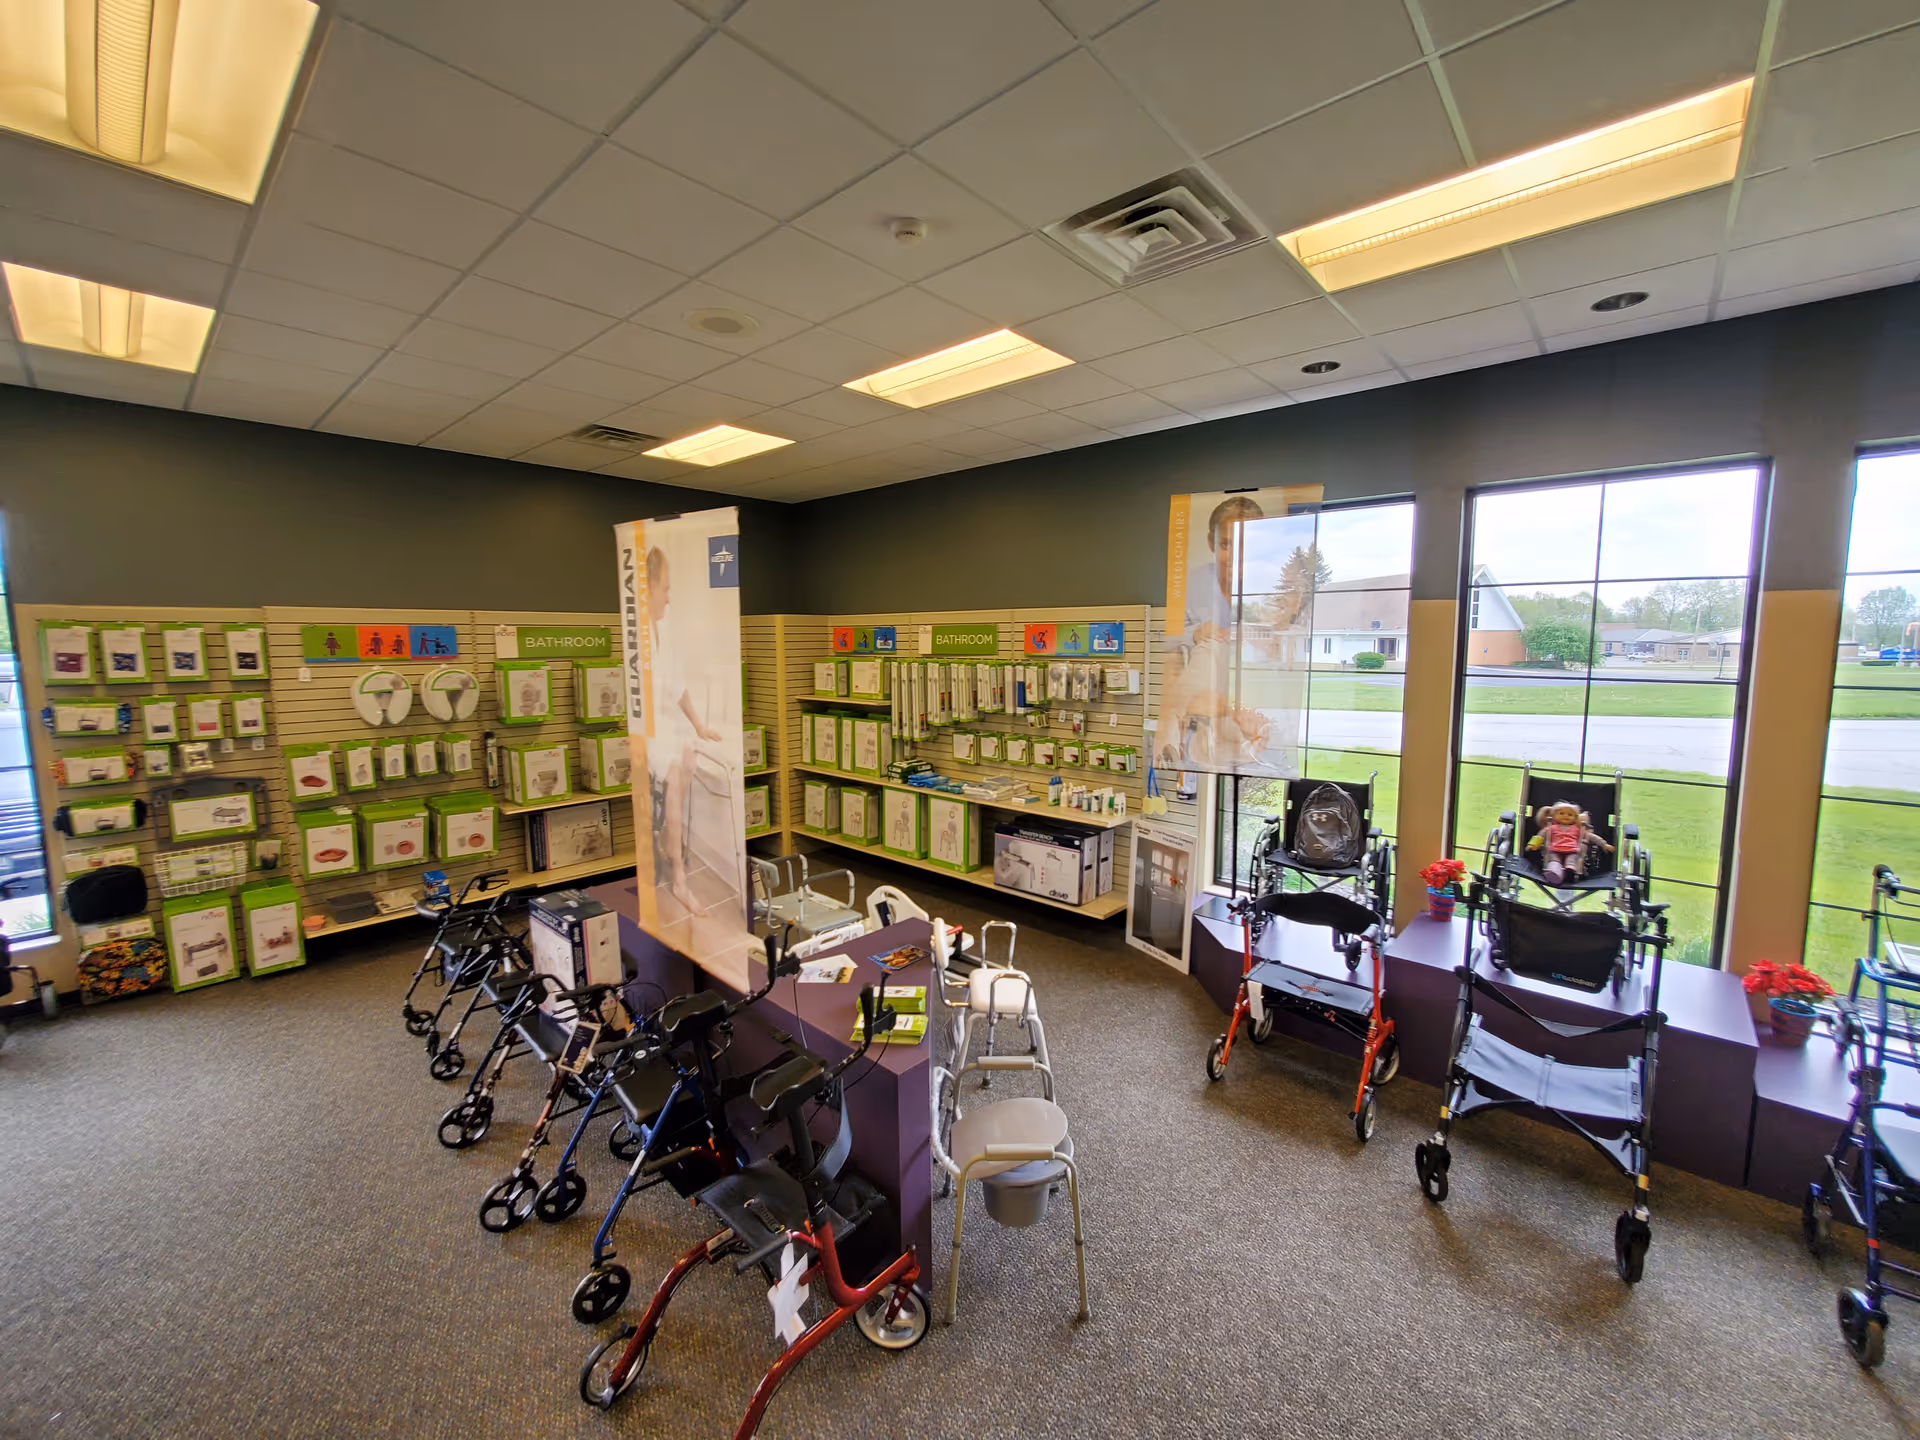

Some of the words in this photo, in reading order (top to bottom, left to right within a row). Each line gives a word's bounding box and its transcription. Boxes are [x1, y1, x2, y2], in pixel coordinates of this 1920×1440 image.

[1172, 511, 1186, 598] WHEELCHAIRS
[623, 548, 642, 719] GUARDIAN
[936, 634, 993, 645] BATHROOM
[525, 636, 606, 649] BATHROOM
[1049, 889, 1069, 900] drive
